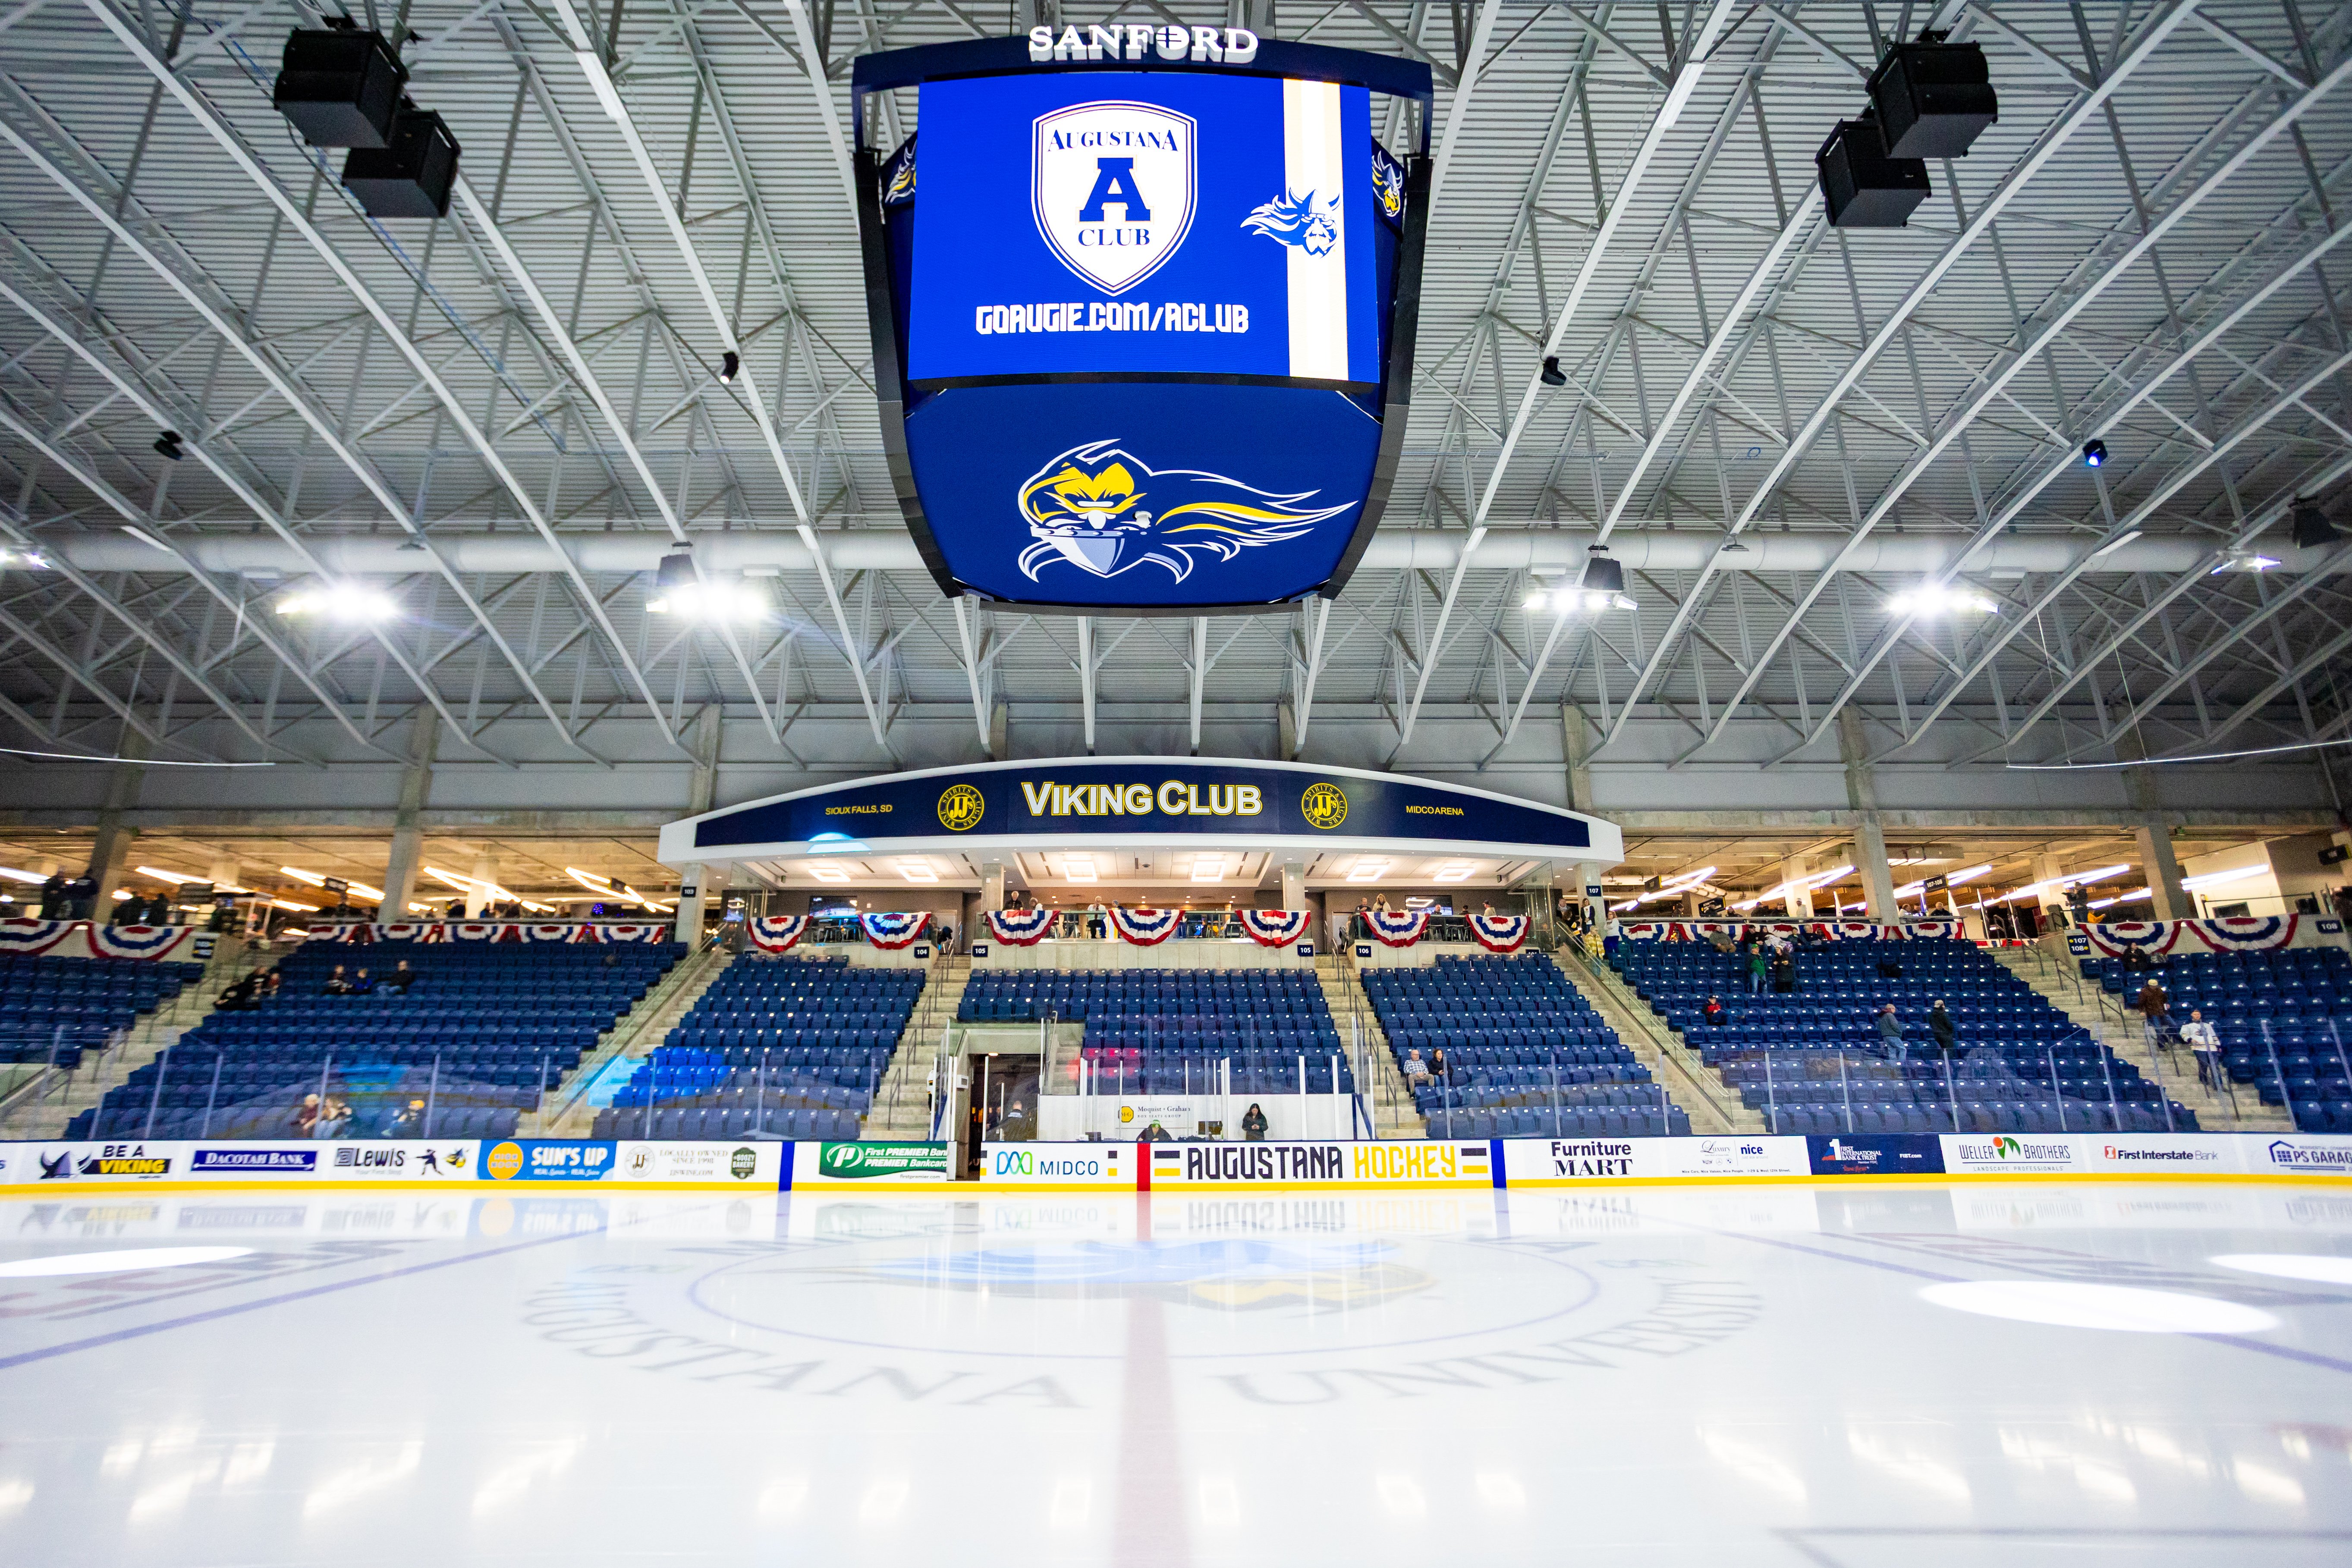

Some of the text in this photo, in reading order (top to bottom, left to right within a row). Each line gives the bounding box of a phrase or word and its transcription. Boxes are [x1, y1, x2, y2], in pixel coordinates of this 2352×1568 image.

[1029, 25, 1258, 61] SANFORD
[1047, 129, 1178, 151] AUGUSTANA
[1079, 157, 1151, 222] A
[1079, 229, 1150, 246] CLUB
[976, 302, 1249, 335] GOAUGIE.COM/ACLUB
[1021, 780, 1263, 816] VIKING CLUB
[825, 804, 893, 816] SIOUX FALLS, SD
[1406, 805, 1464, 816] MIDCO ARENA
[1927, 879, 1943, 888] 107-108
[103, 1144, 145, 1158] BE A
[865, 1148, 884, 1156] First
[885, 1148, 929, 1156] PREMIER
[1551, 1141, 1632, 1156] Furniture
[1700, 1140, 1731, 1153] Luxury
[1740, 1144, 1764, 1155] nice
[1959, 1144, 2071, 1159] WELLER BROTHERS
[205, 1152, 306, 1164] DACOTAH BANK
[354, 1148, 406, 1167] Lewis
[531, 1147, 581, 1166] SUN'S
[583, 1147, 608, 1166] UP
[1188, 1145, 1457, 1180] AUGUSTANA HOCKEY
[2118, 1150, 2218, 1160] First Interstate Bank
[2293, 1150, 2309, 1163] PS
[99, 1159, 165, 1174] VIKING
[865, 1159, 908, 1167] PREMIER
[1040, 1161, 1098, 1175] MIDCO
[1553, 1159, 1633, 1176] MART
[519, 1276, 1764, 1408] AUGUSTANA UNIVERSITY
